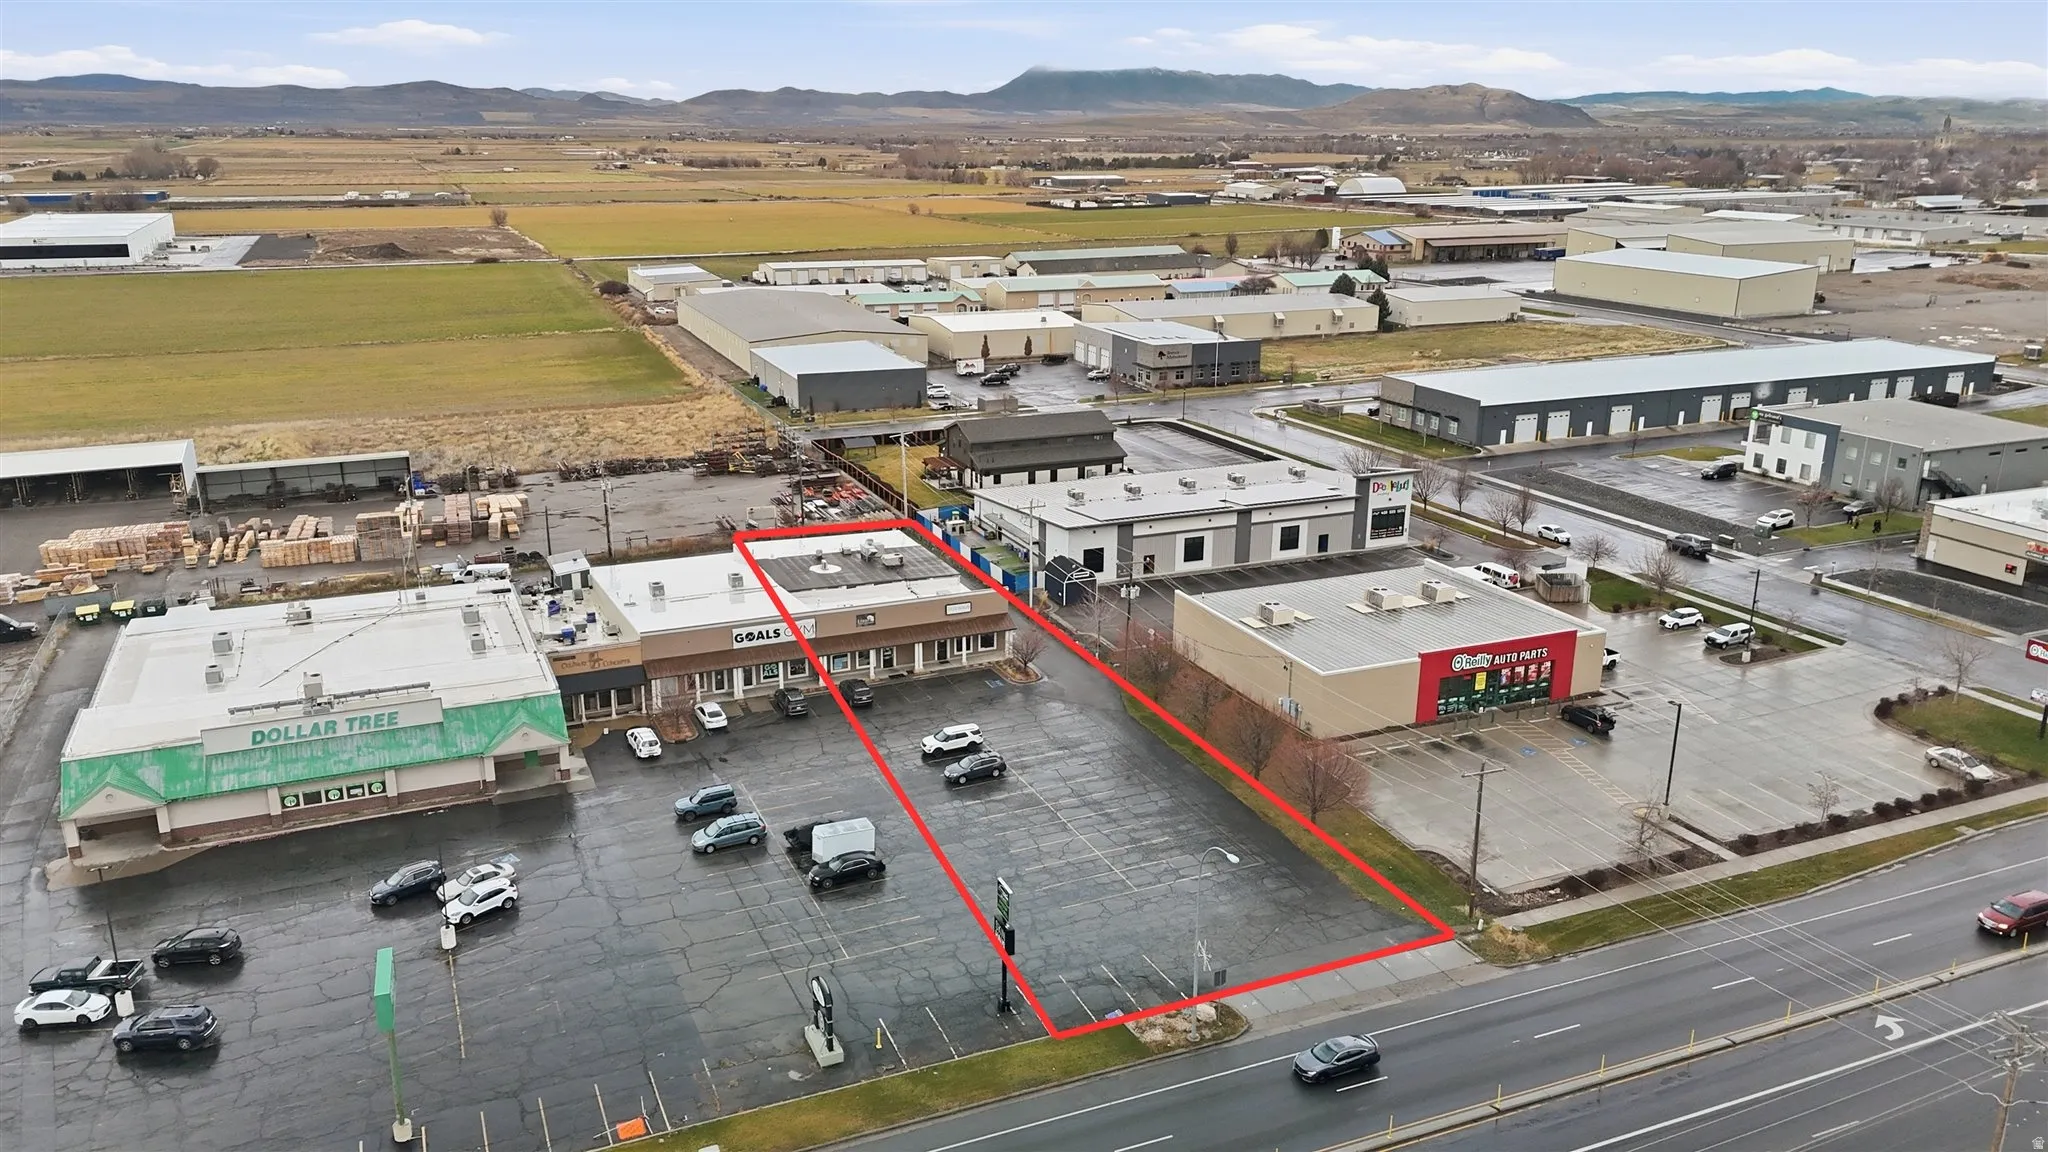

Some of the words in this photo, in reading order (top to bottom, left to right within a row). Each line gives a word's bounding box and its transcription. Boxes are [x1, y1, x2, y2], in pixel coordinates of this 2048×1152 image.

[734, 628, 781, 643] GOALS
[784, 624, 814, 637] GM
[1451, 652, 1493, 672] O'Reilly
[1493, 652, 1518, 665] AUTO
[1519, 648, 1549, 660] PARTS
[251, 719, 338, 746] DOLLAR
[345, 710, 399, 732] TREE
